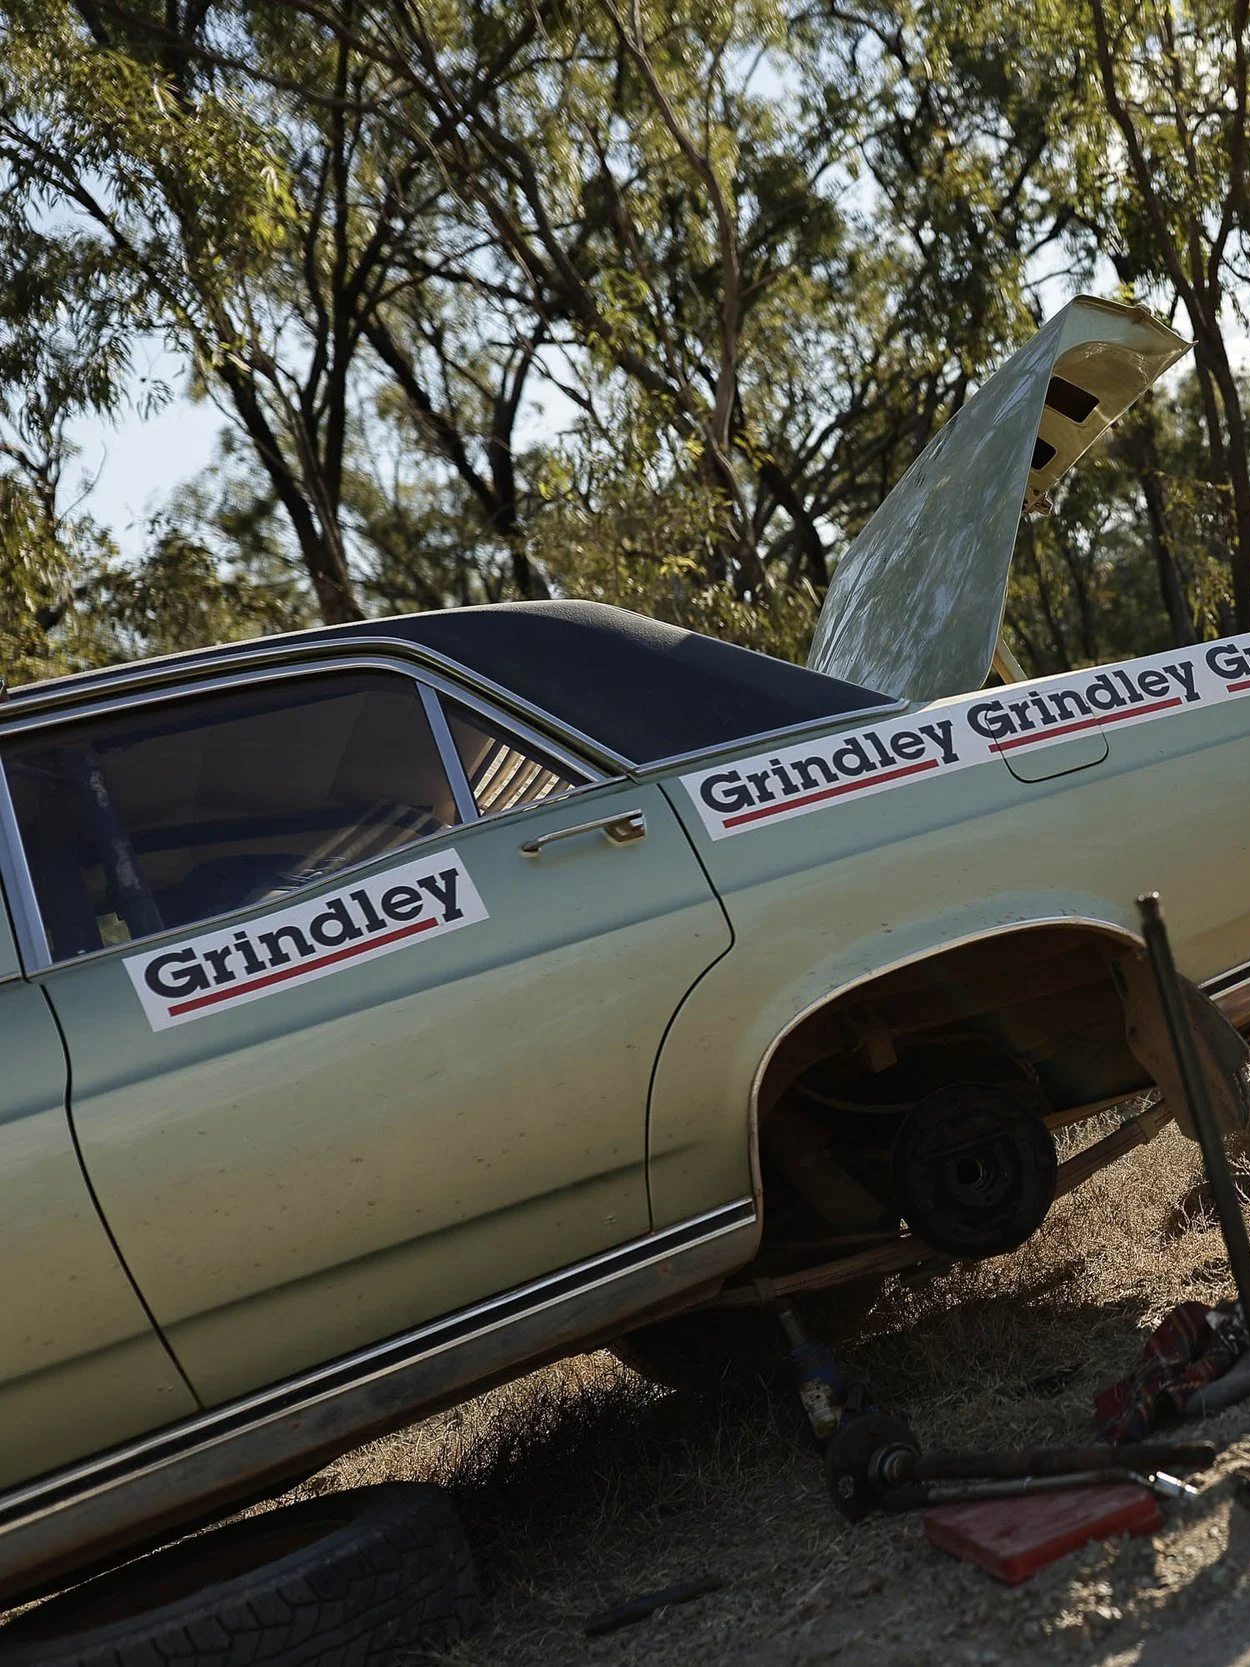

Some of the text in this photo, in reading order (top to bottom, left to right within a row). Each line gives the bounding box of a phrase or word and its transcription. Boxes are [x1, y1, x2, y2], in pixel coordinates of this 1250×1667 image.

[967, 660, 1201, 739] Grindley
[700, 719, 960, 814] Grindley
[144, 867, 464, 999] Grindley
